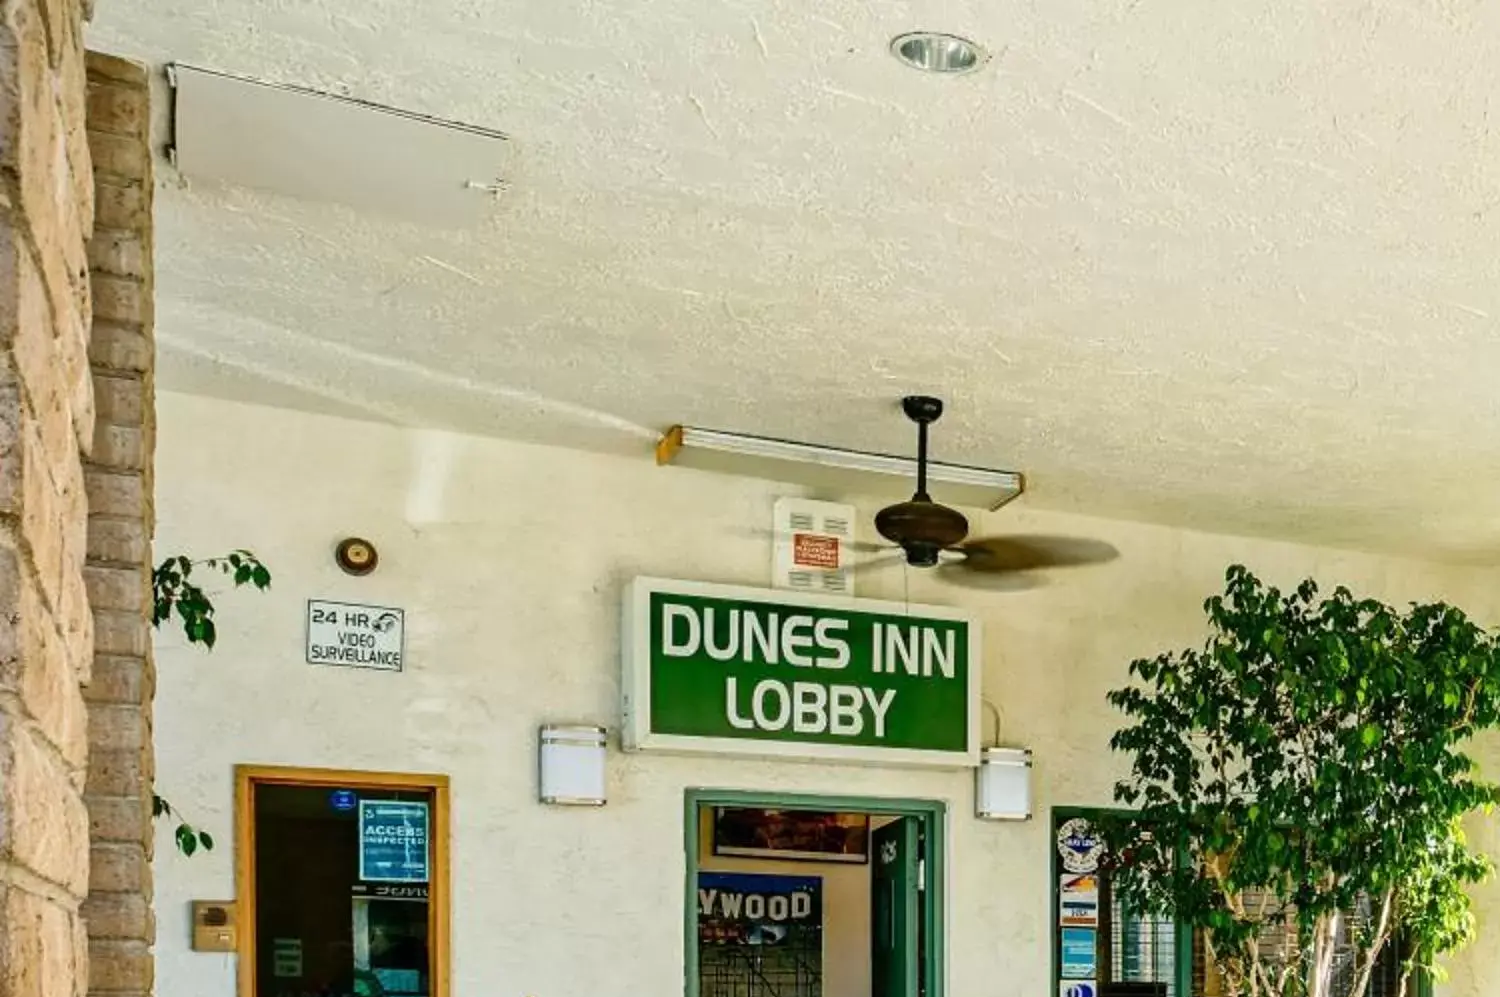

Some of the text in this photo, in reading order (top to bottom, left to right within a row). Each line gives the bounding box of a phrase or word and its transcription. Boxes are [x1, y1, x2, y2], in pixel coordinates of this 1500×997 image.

[312, 609, 369, 628] 24 HR
[337, 631, 376, 649] VIDEO
[662, 602, 956, 679] DUNES INN
[311, 644, 401, 666] SURVEILLANCE
[726, 676, 897, 738] LOBBY
[698, 888, 812, 921] YWOOD
